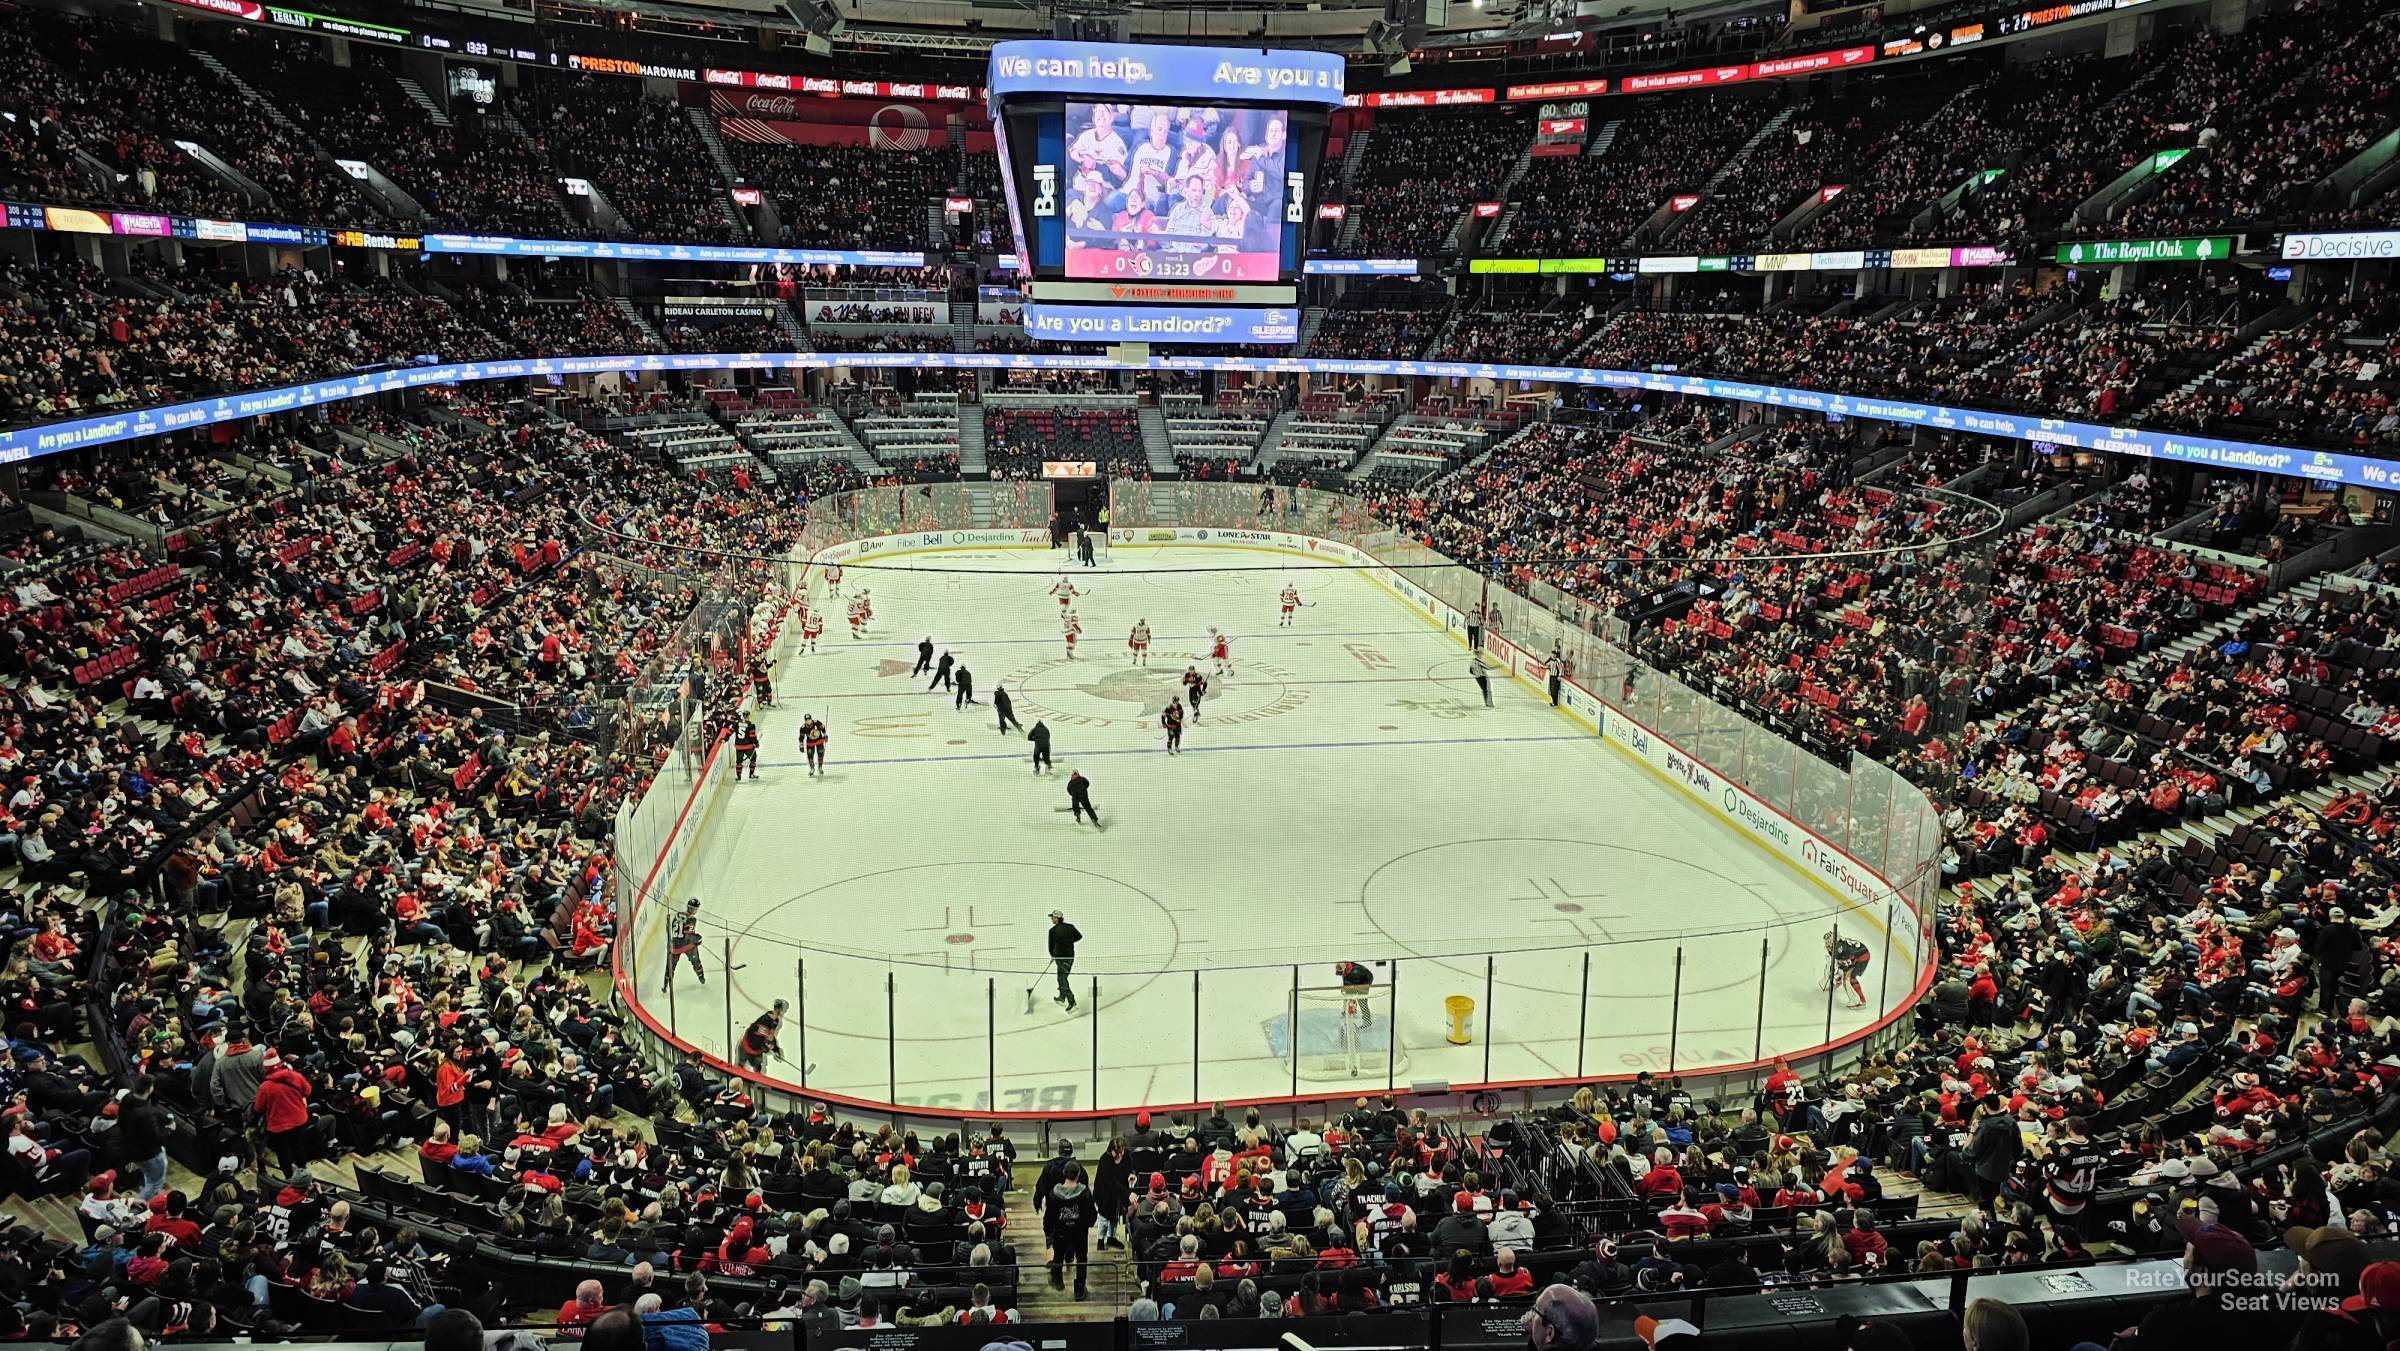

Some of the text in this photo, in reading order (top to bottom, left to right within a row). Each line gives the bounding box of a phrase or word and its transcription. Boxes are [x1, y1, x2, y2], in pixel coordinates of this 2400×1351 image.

[458, 67, 478, 80] GO
[998, 56, 1330, 88] We can help. Are you a
[473, 90, 493, 104] GO
[1541, 104, 1556, 116] GO
[1034, 164, 1056, 217] Bell
[1288, 172, 1304, 223] Bell
[2094, 240, 2183, 262] The Royal Oak
[2308, 236, 2392, 258] Decisive
[1116, 256, 1126, 272] 0
[1156, 264, 1190, 276] 13:23
[1222, 260, 1232, 274] 0
[1764, 256, 1788, 268] MNP
[664, 307, 762, 316] RIDEAU CARLETON CASINO
[1038, 314, 1062, 330] Are
[1070, 318, 1103, 334] you
[1110, 318, 1121, 332] a
[1965, 416, 2016, 434] We can help.
[38, 433, 55, 449] Are
[56, 430, 74, 447] you
[2164, 441, 2184, 456] Are
[2186, 445, 2208, 461] you
[2210, 449, 2218, 460] a
[2363, 466, 2386, 482] We
[2376, 498, 2392, 508] 117
[923, 534, 942, 546] Bell
[967, 532, 1015, 544] Desjardins
[1218, 531, 1272, 541] LONE STAR
[738, 726, 746, 739] 5
[1611, 718, 1627, 741] Fibe
[1632, 729, 1649, 756] Bell
[1738, 799, 1790, 846] Desjardins
[1820, 852, 1880, 905] FairSquare
[2047, 1162, 2060, 1176] 41
[2070, 1167, 2097, 1194] 41
